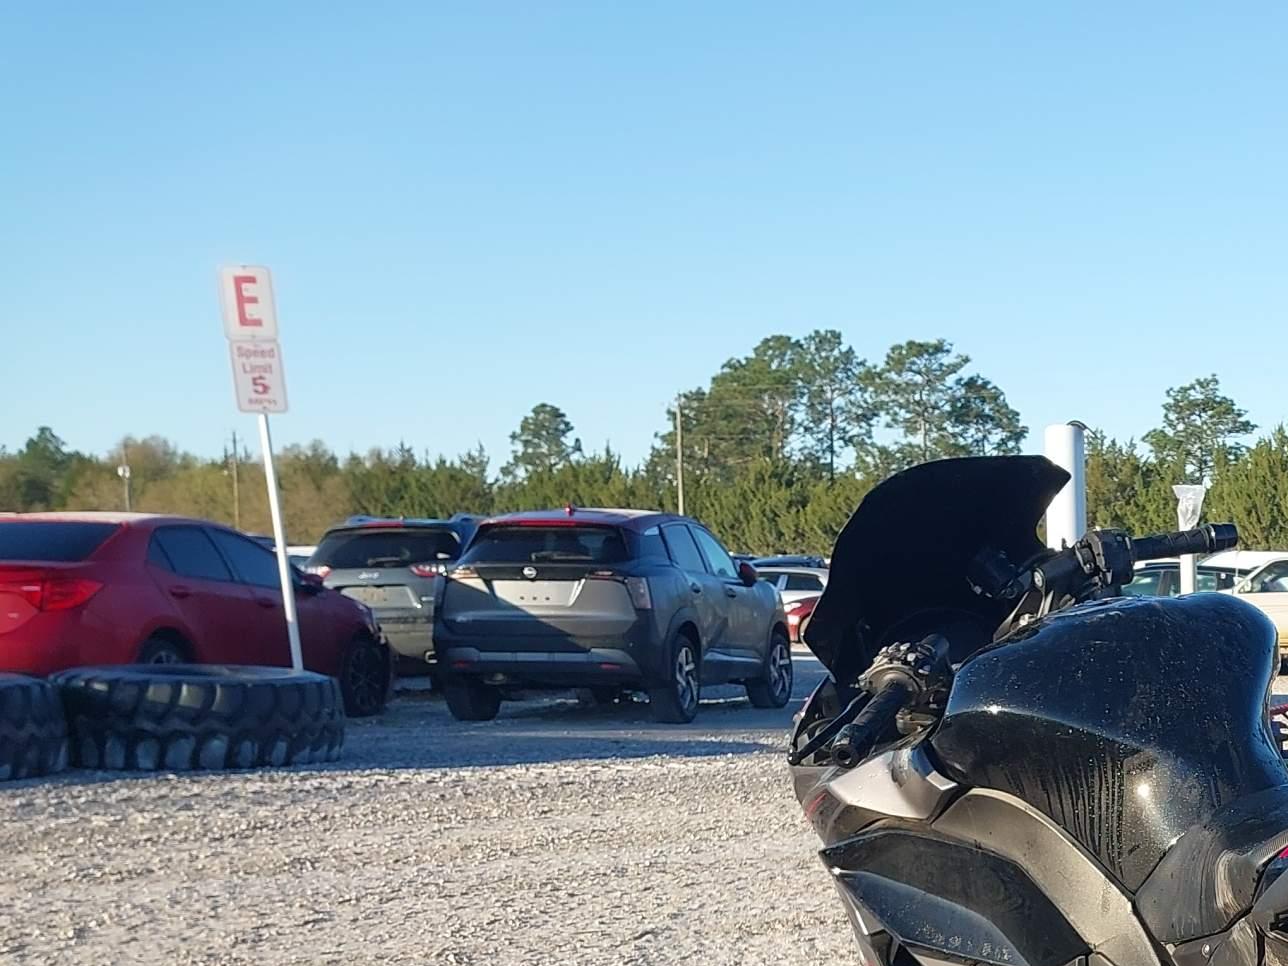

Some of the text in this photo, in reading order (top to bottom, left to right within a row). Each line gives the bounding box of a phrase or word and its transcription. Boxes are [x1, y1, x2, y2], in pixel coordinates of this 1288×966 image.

[233, 275, 262, 327] E
[237, 346, 275, 360] Speed
[251, 375, 270, 395] 5
